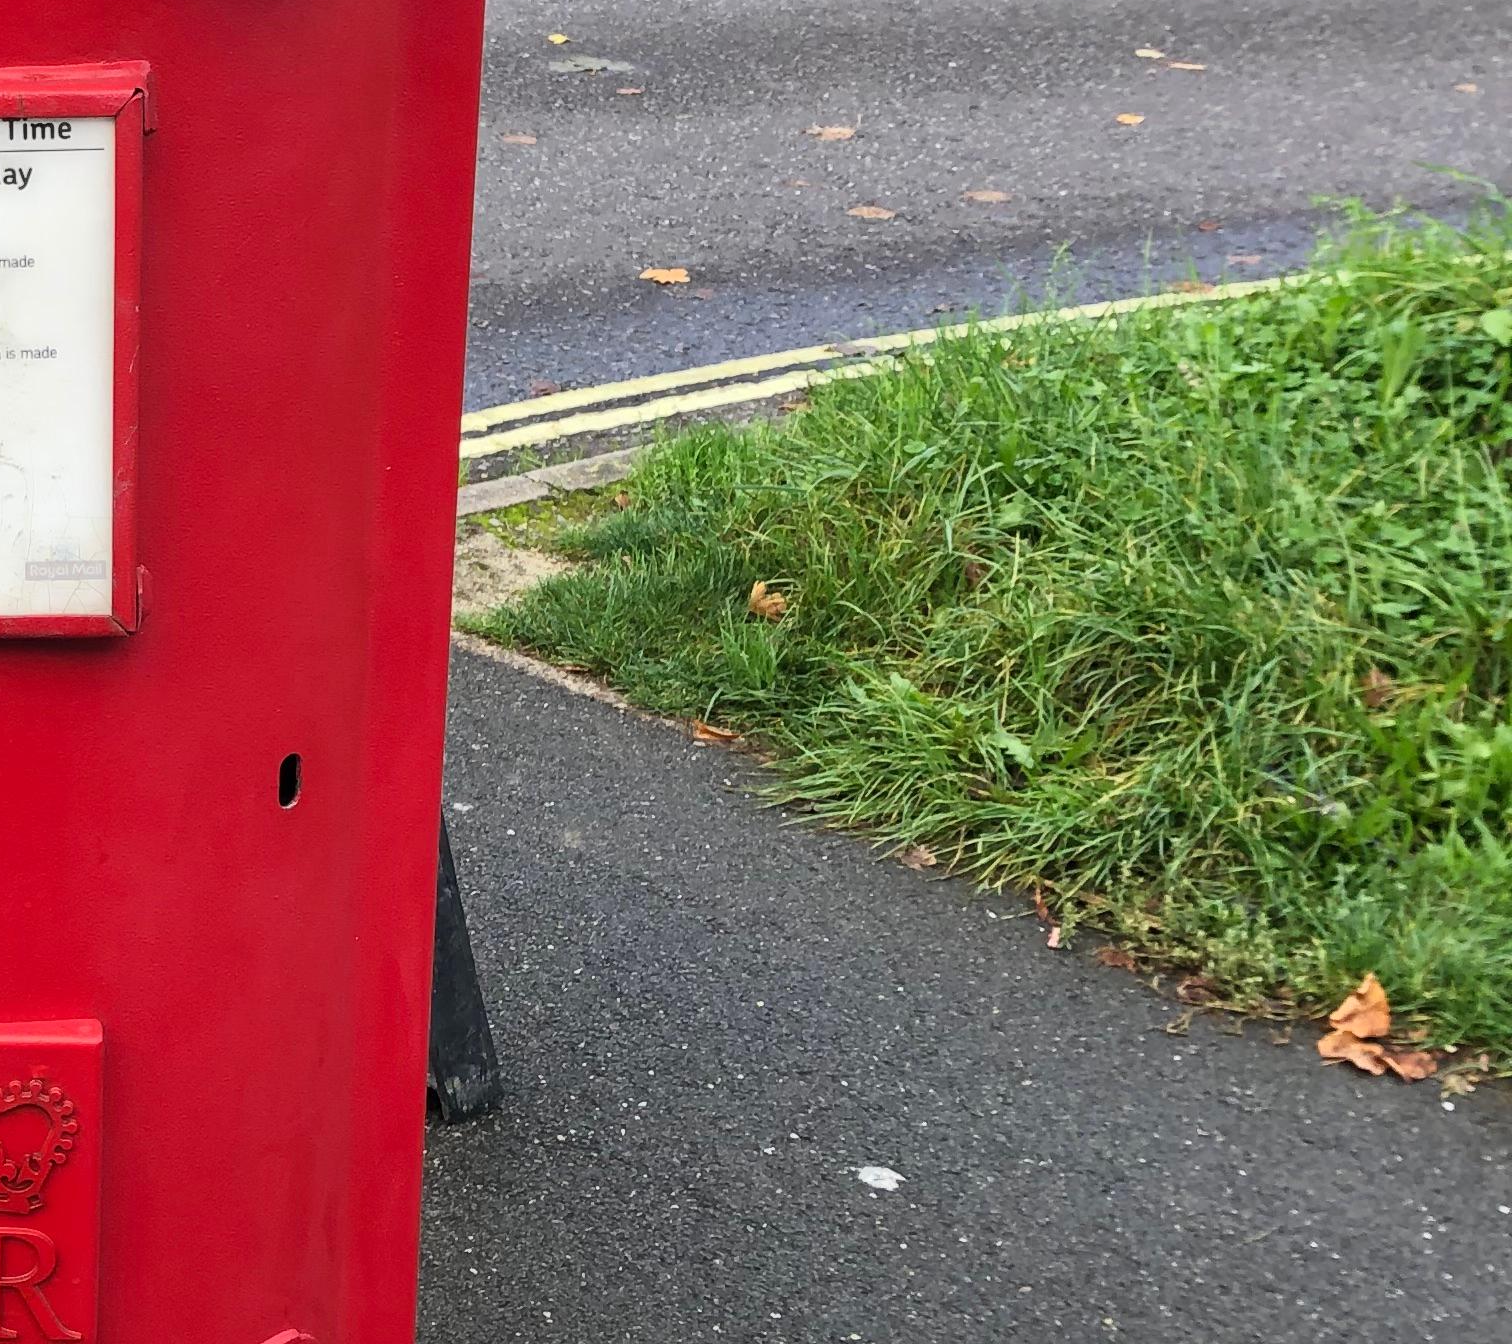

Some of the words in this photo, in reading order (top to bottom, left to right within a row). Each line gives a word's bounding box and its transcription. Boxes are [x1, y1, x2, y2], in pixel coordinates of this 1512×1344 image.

[0, 118, 72, 140] Time
[6, 348, 16, 359] is
[20, 347, 58, 359] made
[30, 564, 68, 578] Royal
[72, 563, 102, 575] Mail
